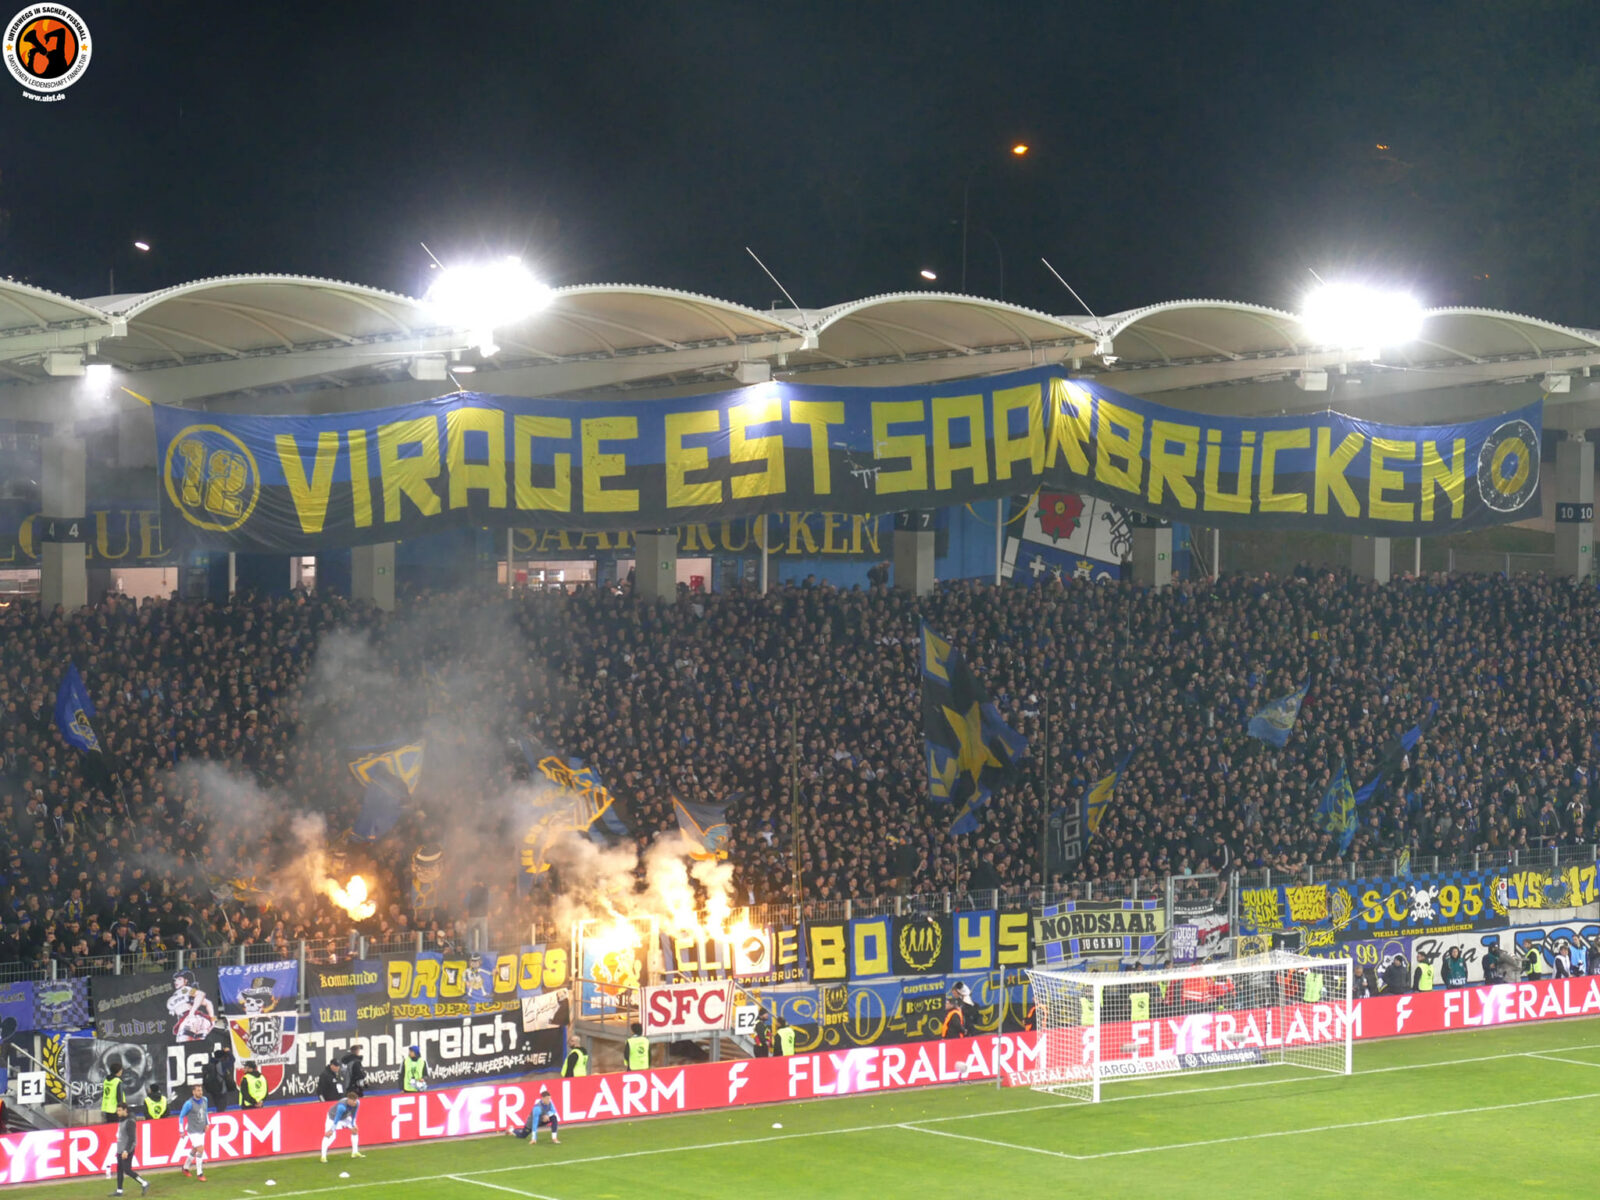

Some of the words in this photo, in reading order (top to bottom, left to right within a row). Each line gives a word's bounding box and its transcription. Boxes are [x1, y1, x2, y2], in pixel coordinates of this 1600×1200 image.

[274, 407, 640, 533] VIRAGE
[664, 398, 845, 510] EST
[870, 376, 1465, 523] SAARBRÜCKEN
[922, 514, 931, 527] 7
[1561, 507, 1573, 519] 10
[1581, 507, 1593, 520] 10
[69, 523, 80, 538] 4
[1361, 890, 1408, 923] SC
[1438, 883, 1484, 917] 95
[1040, 912, 1157, 941] NORDSAAR
[1373, 929, 1399, 938] VIEILLE
[1082, 937, 1121, 950] JUGEND
[1356, 943, 1378, 965] 99
[393, 1003, 432, 1018] NUR
[434, 1001, 471, 1015] DER
[648, 988, 725, 1028] SFC
[99, 1017, 167, 1039] Luder
[738, 1012, 756, 1028] E2
[826, 1012, 849, 1026] BOYS
[253, 1021, 275, 1046] 25
[1131, 1001, 1362, 1060] FLYERALARM
[296, 1013, 519, 1075] Frankreich
[788, 1032, 1047, 1097] FLYERALARM
[1200, 1049, 1257, 1064] Volkswagen
[21, 1079, 43, 1097] E1
